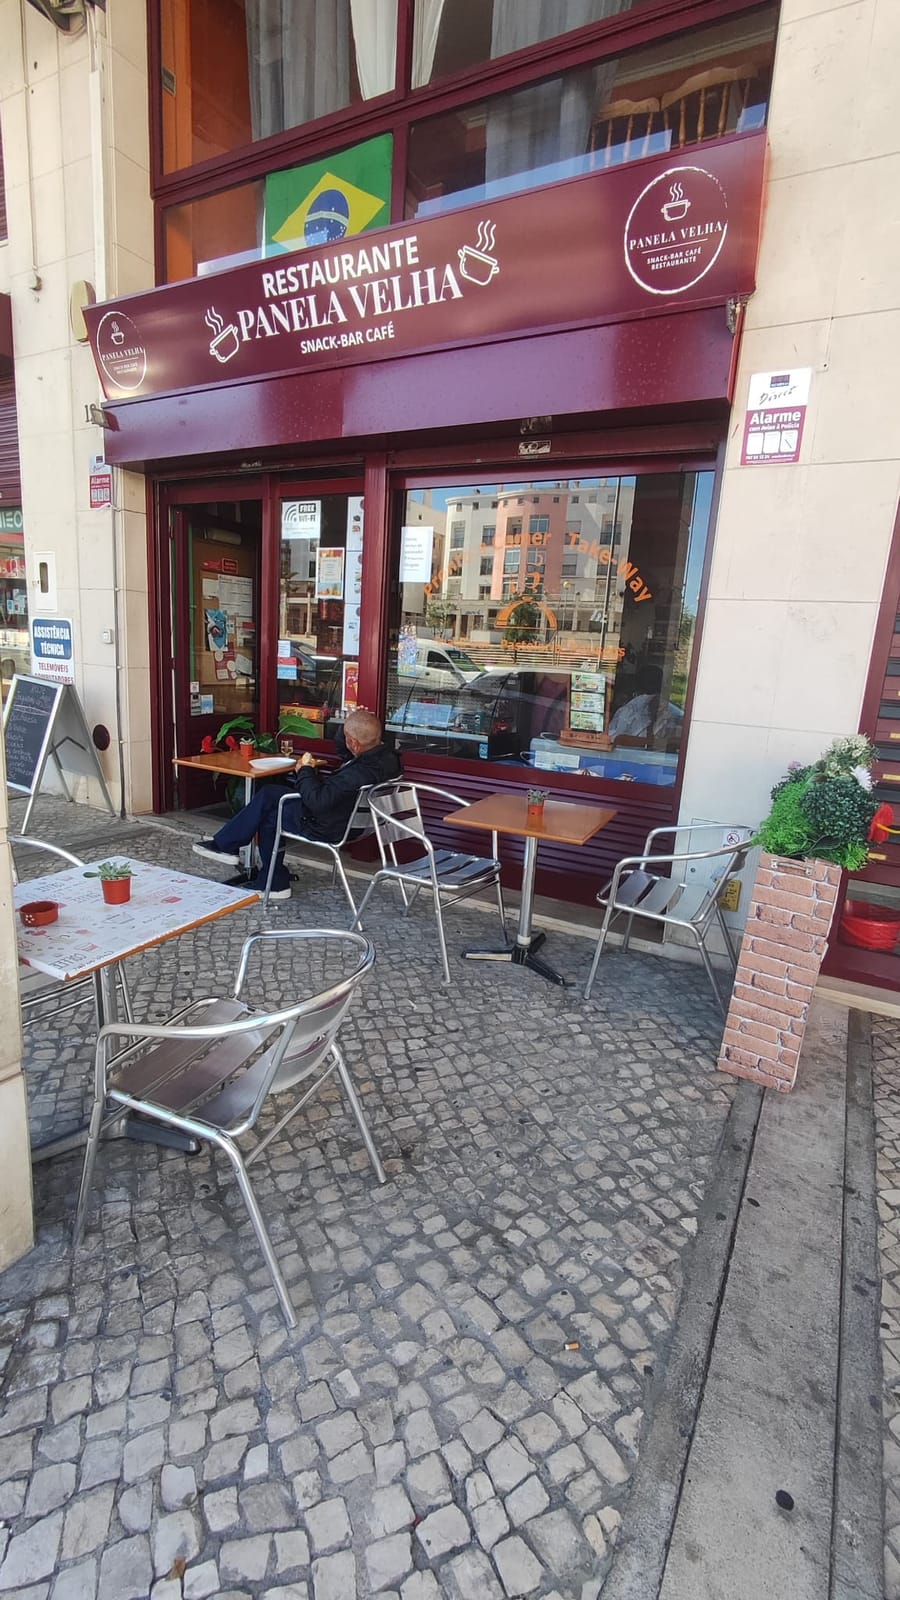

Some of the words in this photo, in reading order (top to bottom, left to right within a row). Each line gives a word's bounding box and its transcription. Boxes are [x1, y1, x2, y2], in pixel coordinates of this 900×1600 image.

[629, 231, 676, 250] PANELA
[680, 221, 723, 239] VELHA
[647, 251, 684, 265] SNACK-BAR
[685, 246, 702, 257] CAFÉ
[651, 255, 697, 270] RESTAURANTE
[261, 235, 420, 298] RESTAURANTE
[236, 290, 348, 342] PANELA
[349, 263, 464, 319] VELHA
[300, 328, 364, 354] SNACK-BAR
[366, 321, 395, 343] CAFÉ
[102, 350, 123, 361] PANELA
[123, 346, 144, 357] VELHA
[750, 411, 802, 425] Alarme
[34, 624, 71, 641] ASSISTÊNCIA
[40, 641, 65, 656] TÉCNICA
[38, 661, 69, 673] TELEMÓVEIS
